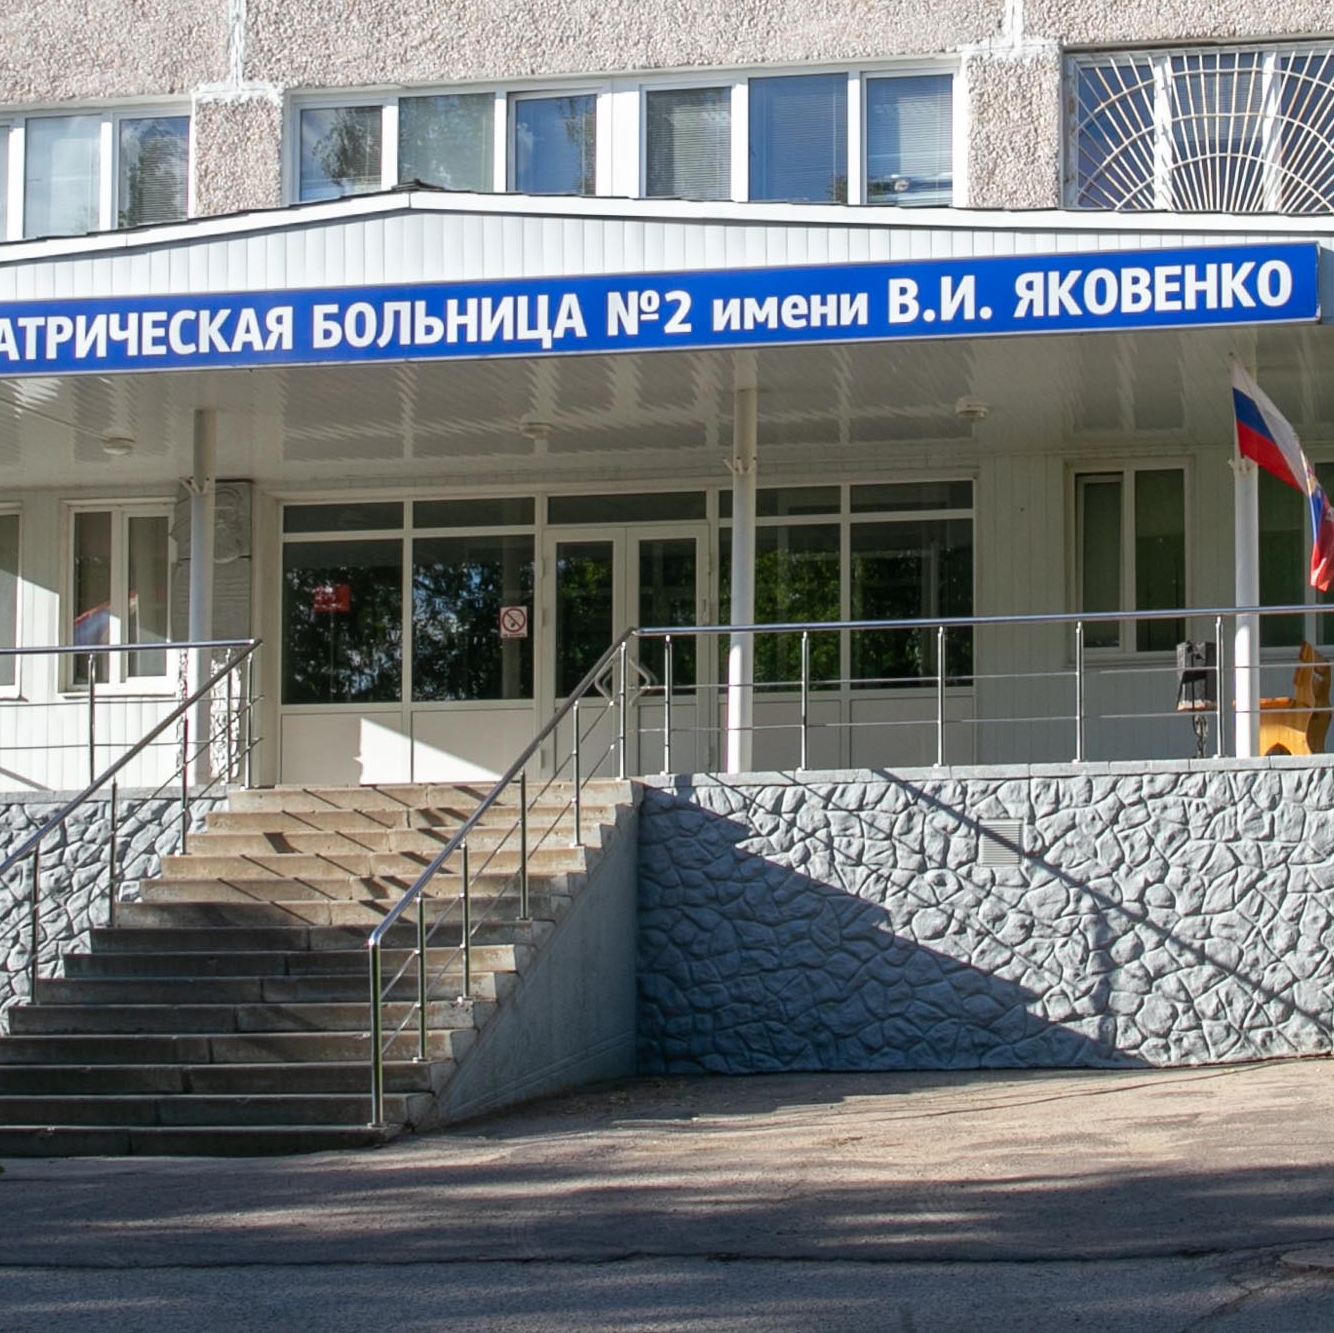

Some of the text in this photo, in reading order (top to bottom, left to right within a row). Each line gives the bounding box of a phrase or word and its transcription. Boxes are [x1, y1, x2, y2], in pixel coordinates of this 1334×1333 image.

[311, 292, 587, 350] БОЛЬНИЦА
[606, 289, 692, 336] №2
[711, 291, 869, 332] имени
[887, 274, 993, 324] В.И.
[1013, 259, 1293, 318] ЯКОВЕНКО
